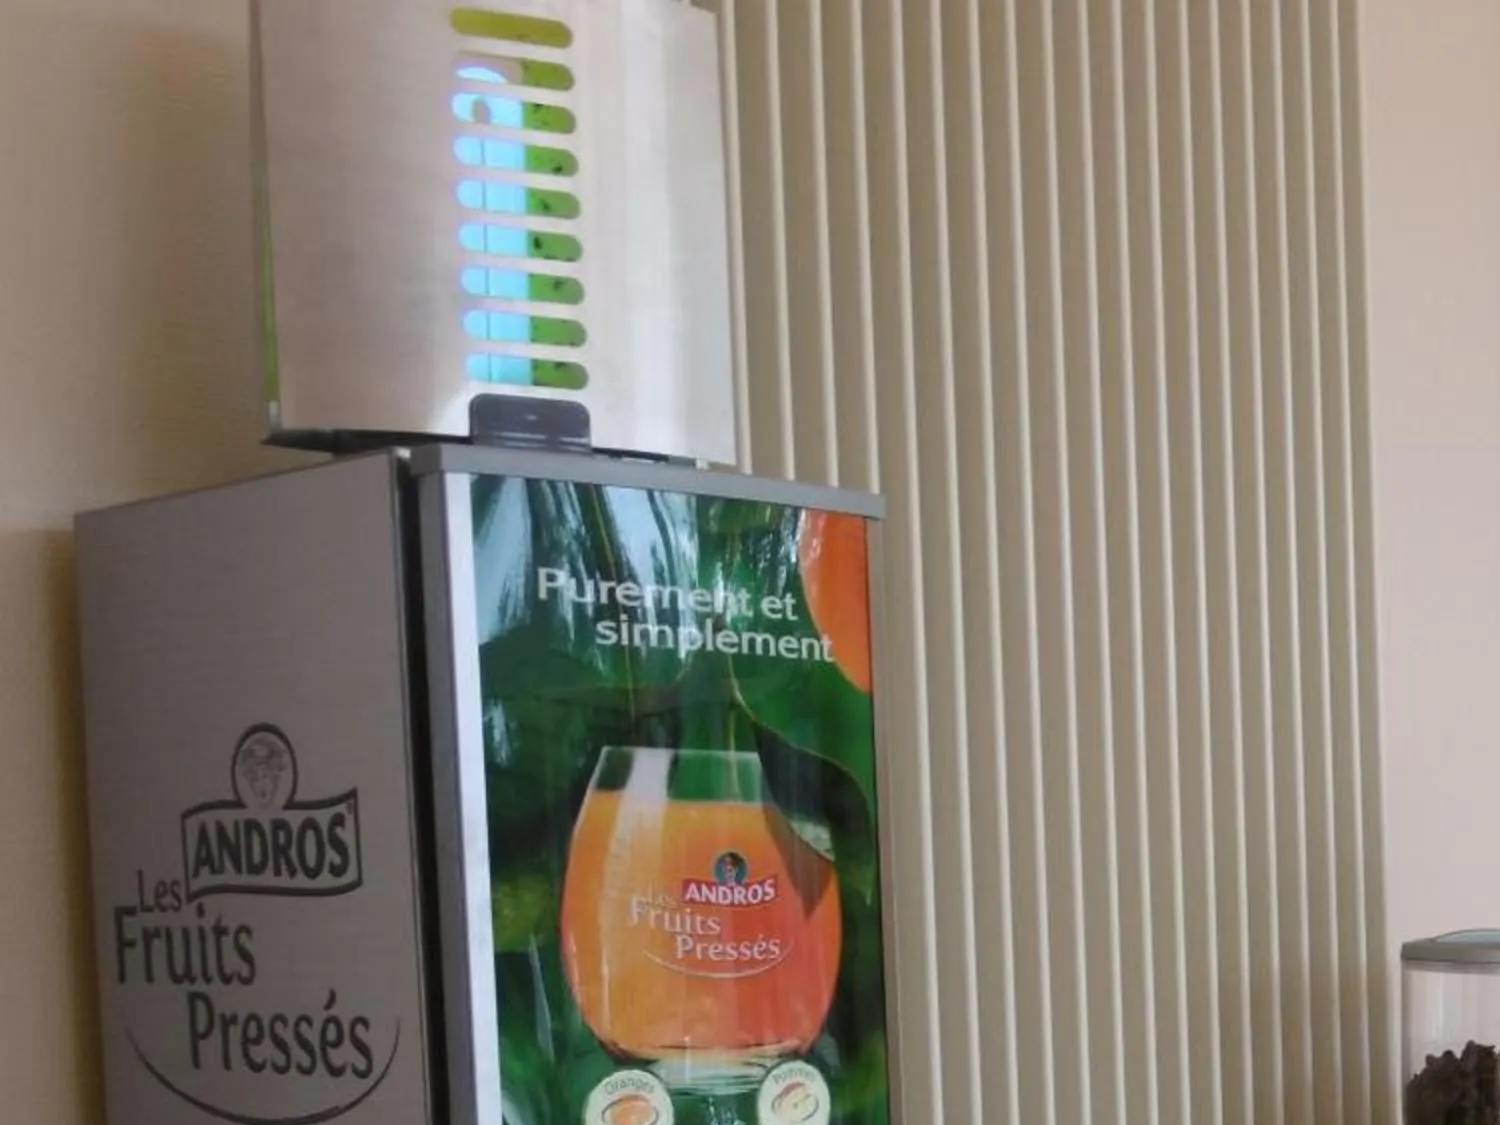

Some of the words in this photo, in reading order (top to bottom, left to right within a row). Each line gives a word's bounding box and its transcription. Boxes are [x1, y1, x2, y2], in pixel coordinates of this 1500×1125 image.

[537, 566, 753, 619] Purement
[761, 591, 799, 621] et
[595, 614, 836, 663] simplement
[192, 812, 350, 880] ANDROS
[137, 869, 184, 914] Les
[629, 896, 722, 935] Fruits
[684, 878, 777, 905] ANDROS
[113, 904, 257, 986] Fruits
[676, 933, 782, 962] Pressés
[186, 988, 375, 1080] Pressés
